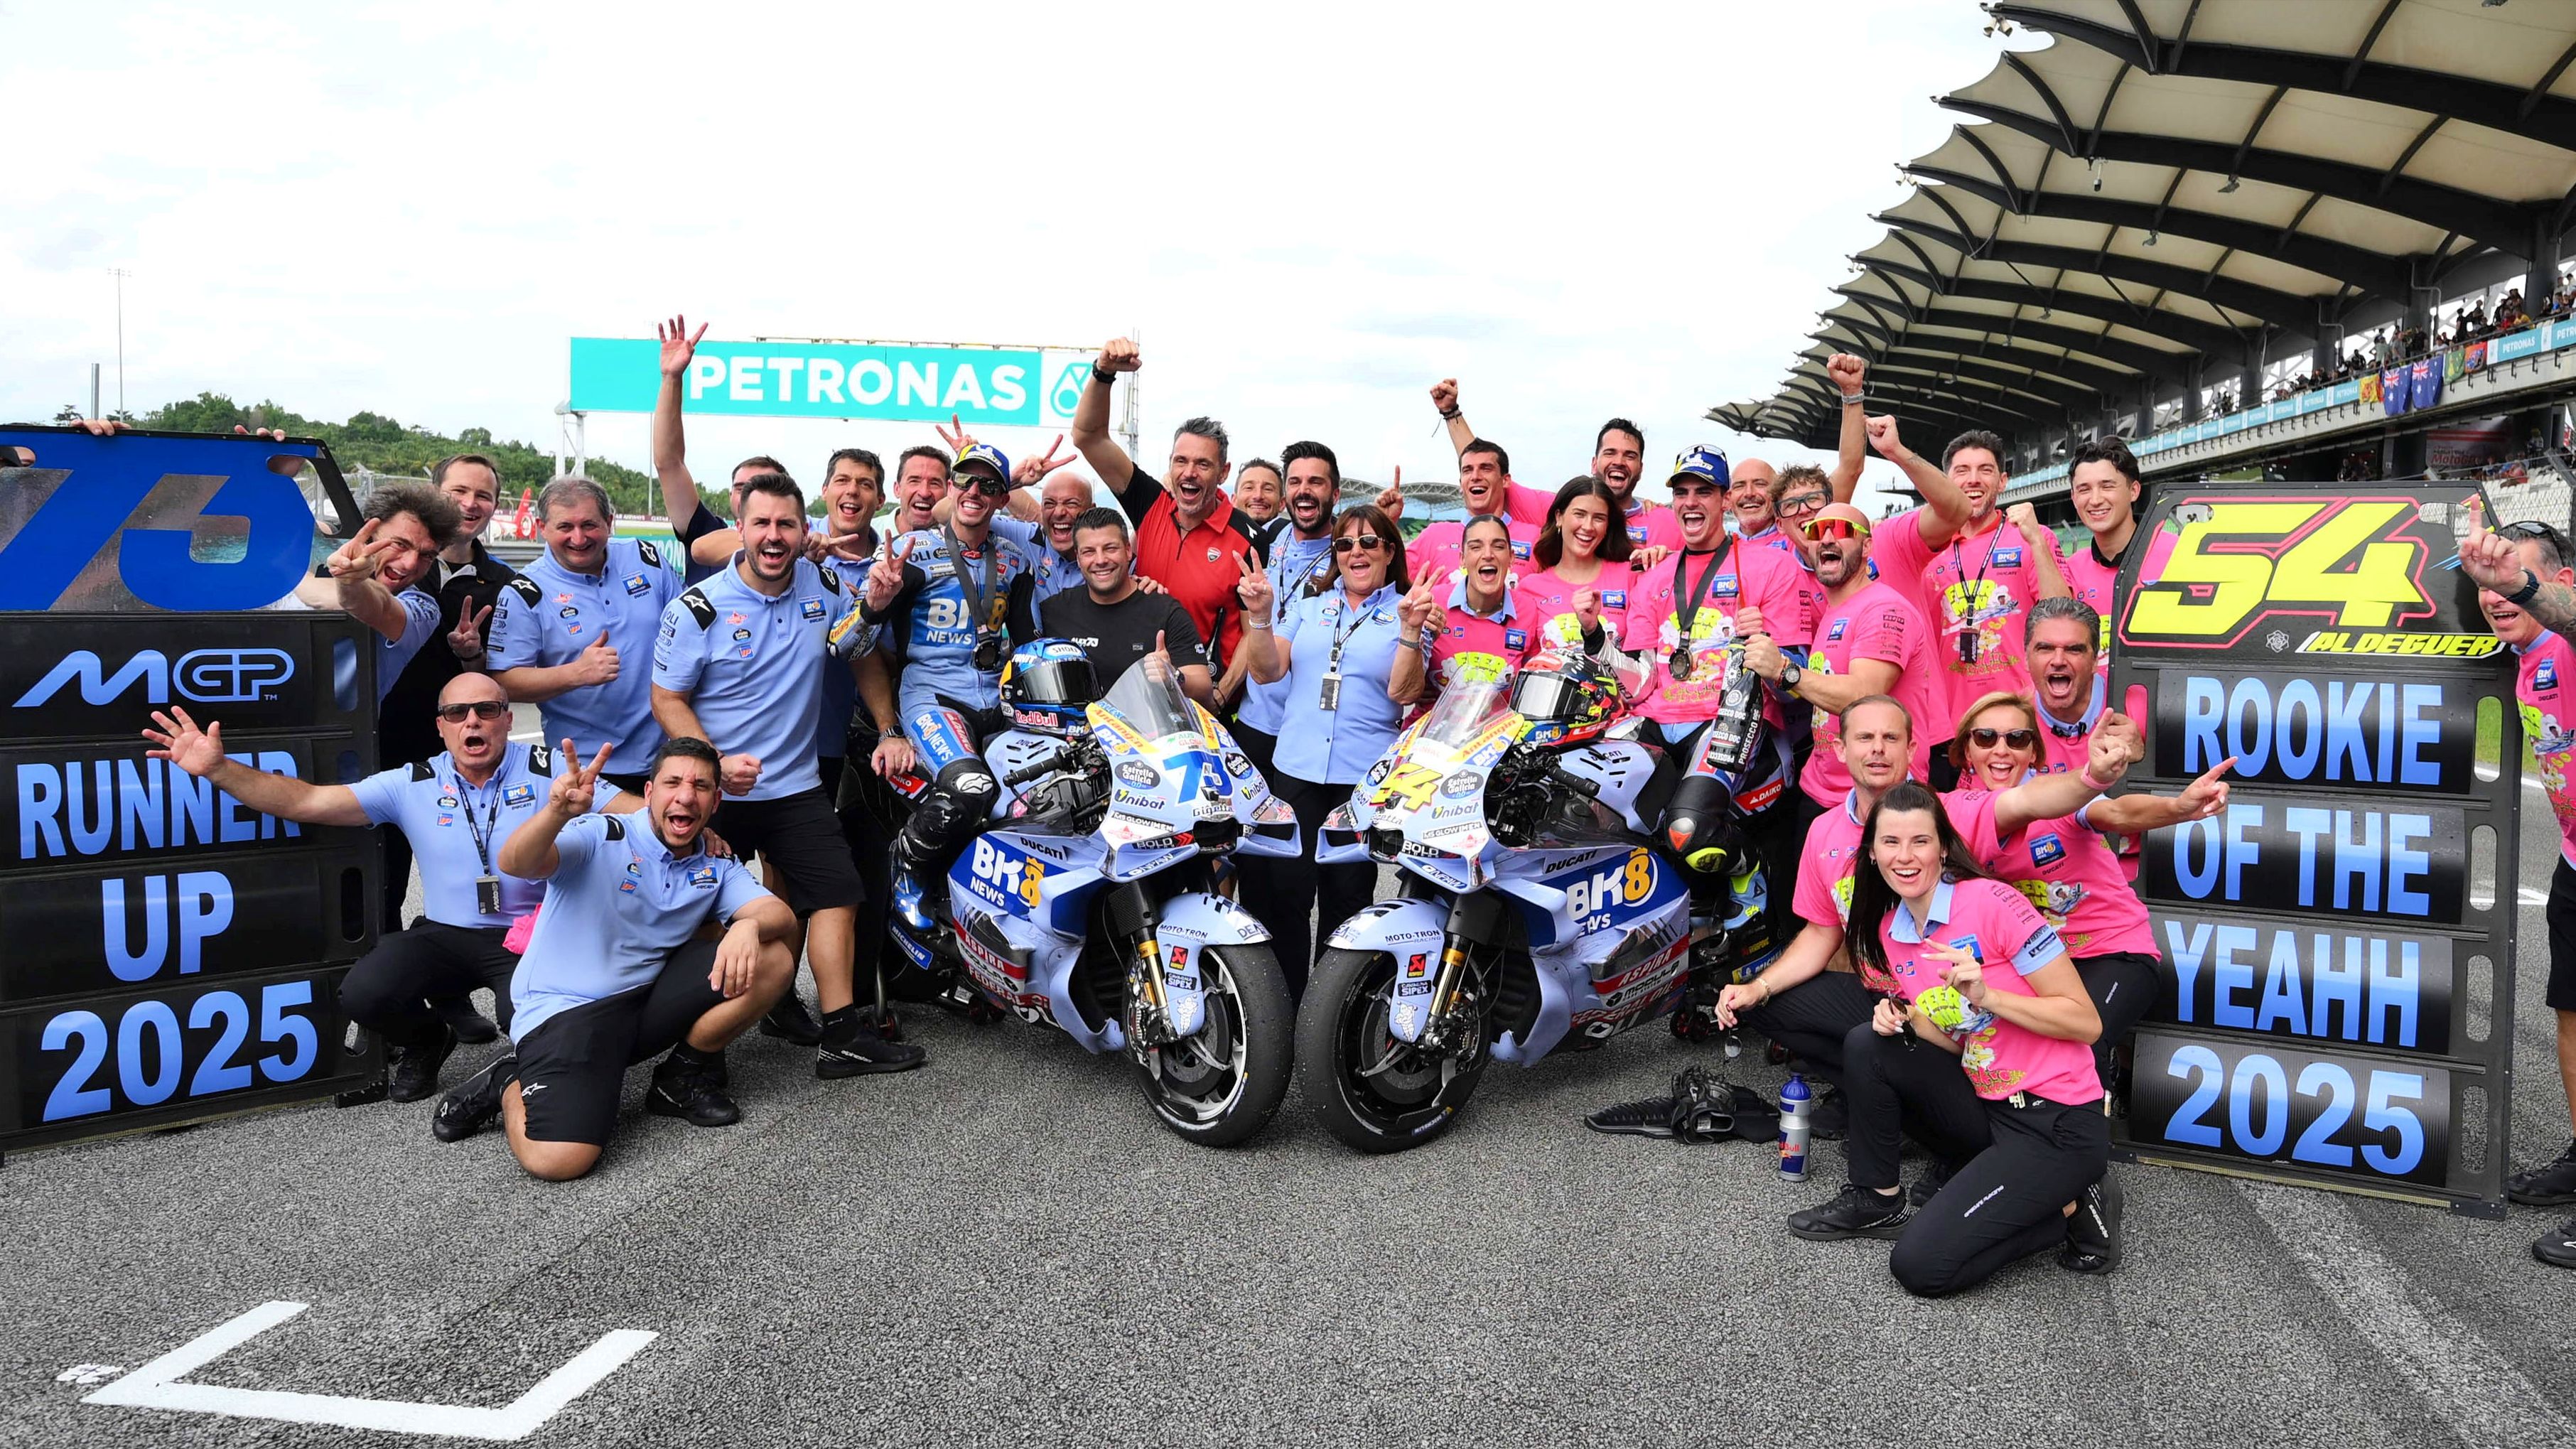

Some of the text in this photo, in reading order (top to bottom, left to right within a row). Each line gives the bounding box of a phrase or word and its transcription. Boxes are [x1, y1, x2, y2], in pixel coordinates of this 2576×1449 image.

[2502, 336, 2536, 354] PETRONAS
[689, 356, 1025, 411] PETRONAS
[2128, 502, 2424, 635] 54
[926, 630, 973, 645] NEWS
[2310, 632, 2500, 655] ALDEGUER
[1015, 711, 1059, 727] Red Bull
[2184, 677, 2442, 785] ROOKIE
[927, 732, 954, 761] NEWS
[1738, 721, 1758, 765] PROSECCO
[1162, 750, 1234, 804] 73
[16, 751, 301, 859] RUNNER
[1114, 789, 1166, 810] Unibat
[1759, 785, 1782, 802] DAIKO
[1124, 814, 1151, 826] GLOW
[1432, 802, 1480, 819] Unibat
[1137, 837, 1173, 849] BOLD
[1436, 827, 1459, 837] GLOW
[1020, 836, 1065, 861] DUCATI
[1402, 840, 1439, 854] BOLD
[1545, 849, 1597, 874] DUCATI
[2174, 804, 2430, 915] OF THE
[971, 836, 1045, 908] BK8
[2042, 862, 2064, 875] DUCATI
[970, 878, 1005, 907] NEWS
[1566, 850, 1654, 922] BK8
[102, 871, 235, 981] UP
[1159, 924, 1209, 938] MOTO-TRON
[1386, 930, 1440, 942] MOTO-TRON
[891, 926, 926, 961] MICHELIN
[965, 933, 1005, 971] ASPIRA
[1617, 947, 1674, 987] ASPIRA
[969, 965, 1025, 1006] FEDERAL
[1168, 978, 1193, 990] SIPEX
[1401, 986, 1428, 996] SIPEX
[2165, 921, 2420, 1047] YEAHH
[41, 980, 318, 1122] 2025
[2164, 1045, 2425, 1175] 2025
